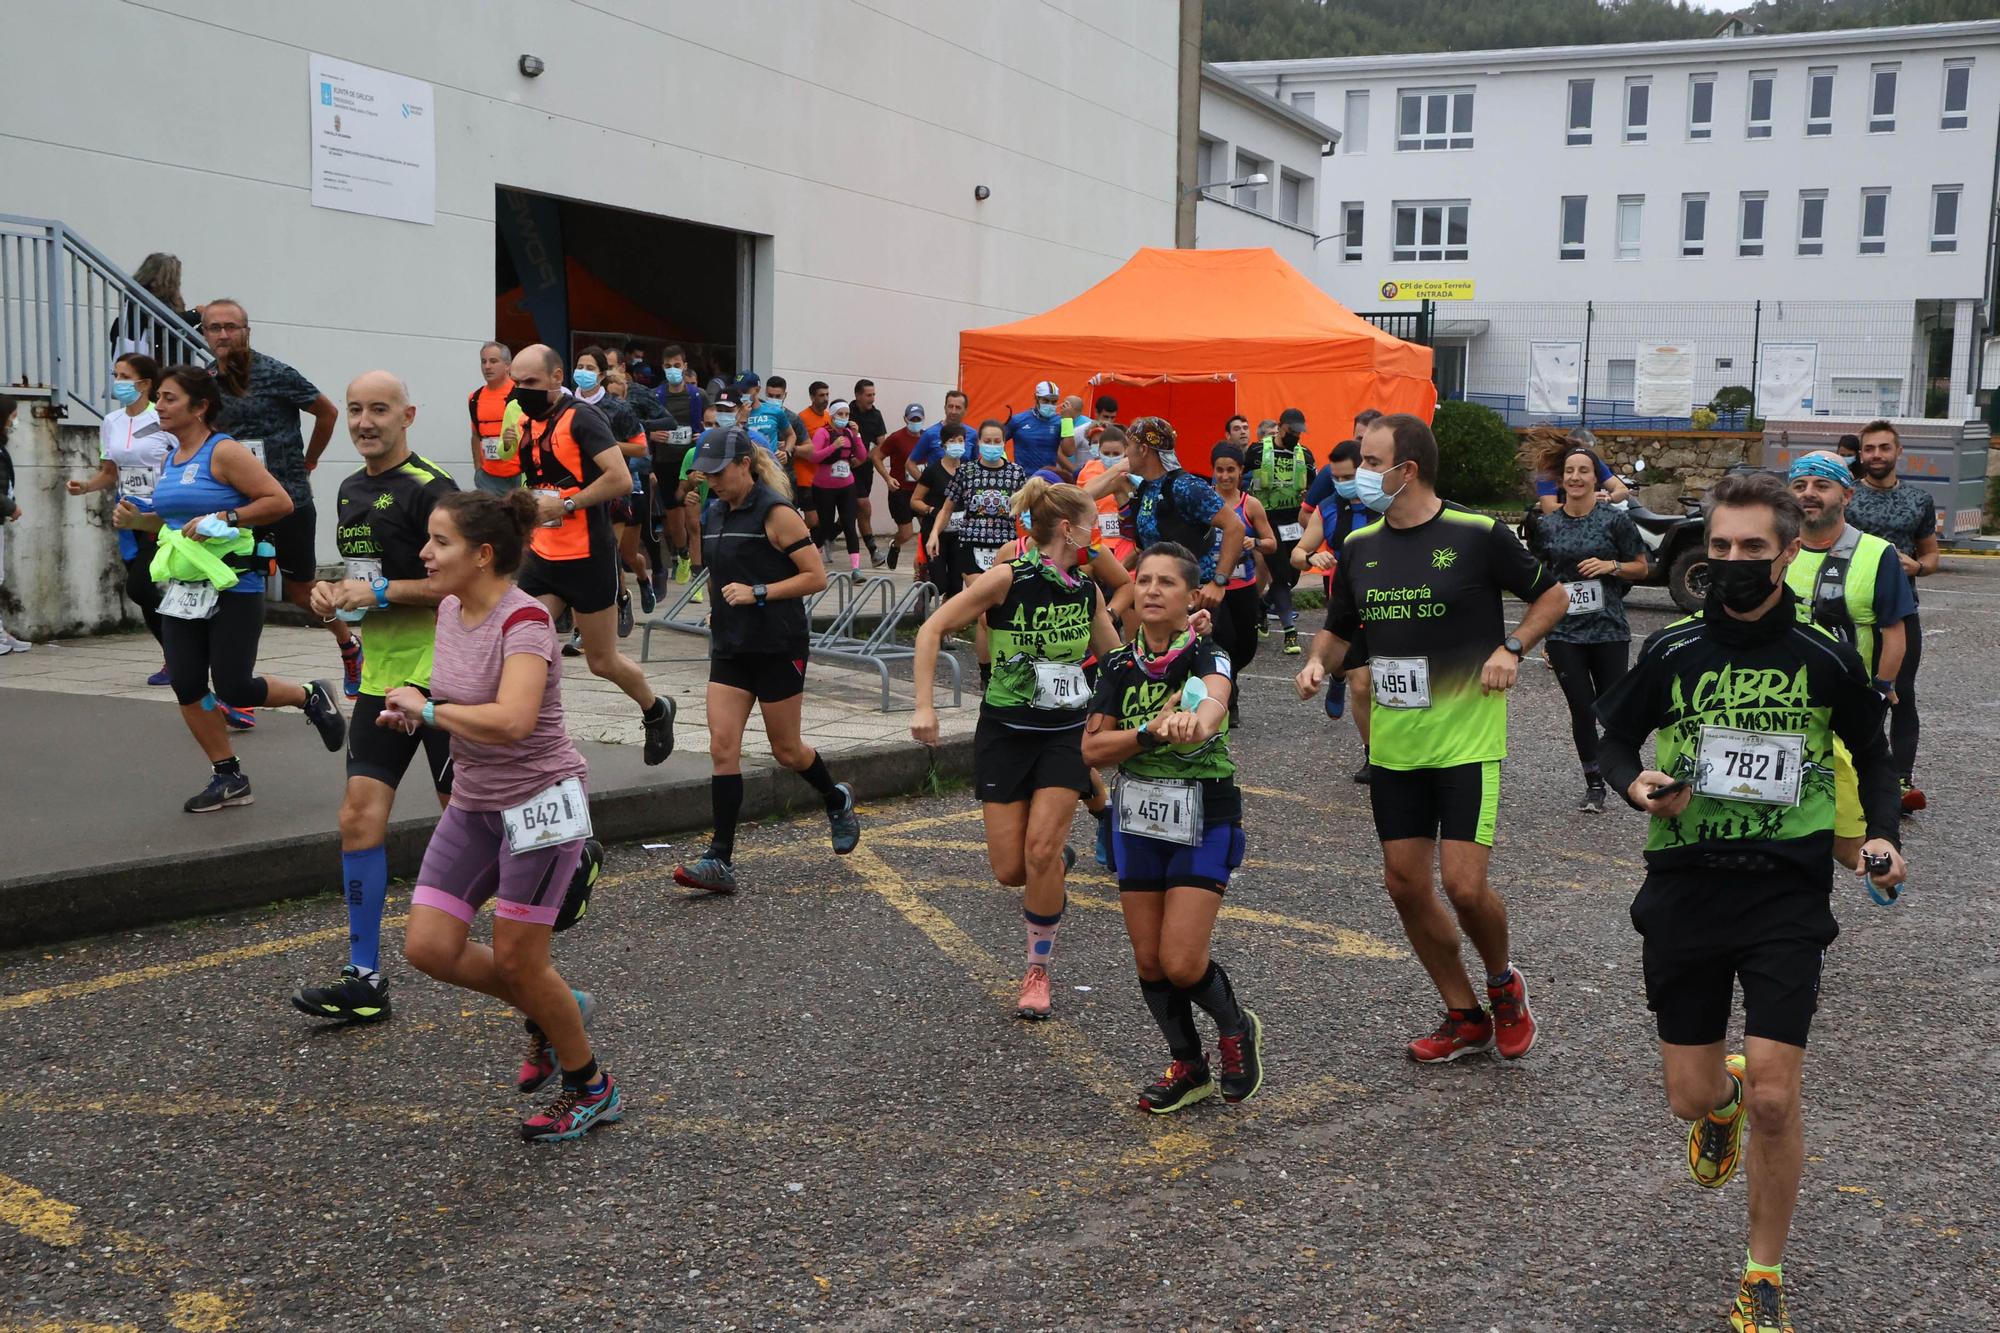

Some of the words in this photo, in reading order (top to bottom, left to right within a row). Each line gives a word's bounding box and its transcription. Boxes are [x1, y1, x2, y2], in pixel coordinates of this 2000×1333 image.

[1400, 282, 1412, 290] CPI
[1413, 282, 1423, 290] de
[1424, 282, 1441, 290] Cova
[1444, 282, 1472, 290] Terreña
[983, 555, 996, 566] 63
[1366, 584, 1432, 603] Floristería
[1570, 591, 1590, 605] 426
[1007, 603, 1027, 631] A
[1032, 596, 1092, 632] CABRA
[1359, 604, 1411, 621] CARMEN
[1417, 603, 1447, 618] SIO
[1010, 632, 1047, 646] TIRA
[1060, 626, 1091, 642] MONT
[1381, 674, 1408, 694] 495
[1666, 672, 1688, 720] A
[1692, 660, 1812, 713] CABRA
[1735, 710, 1813, 731] MONTE
[1724, 750, 1770, 781] 782
[522, 802, 562, 831] 642
[1138, 800, 1170, 823] 457
